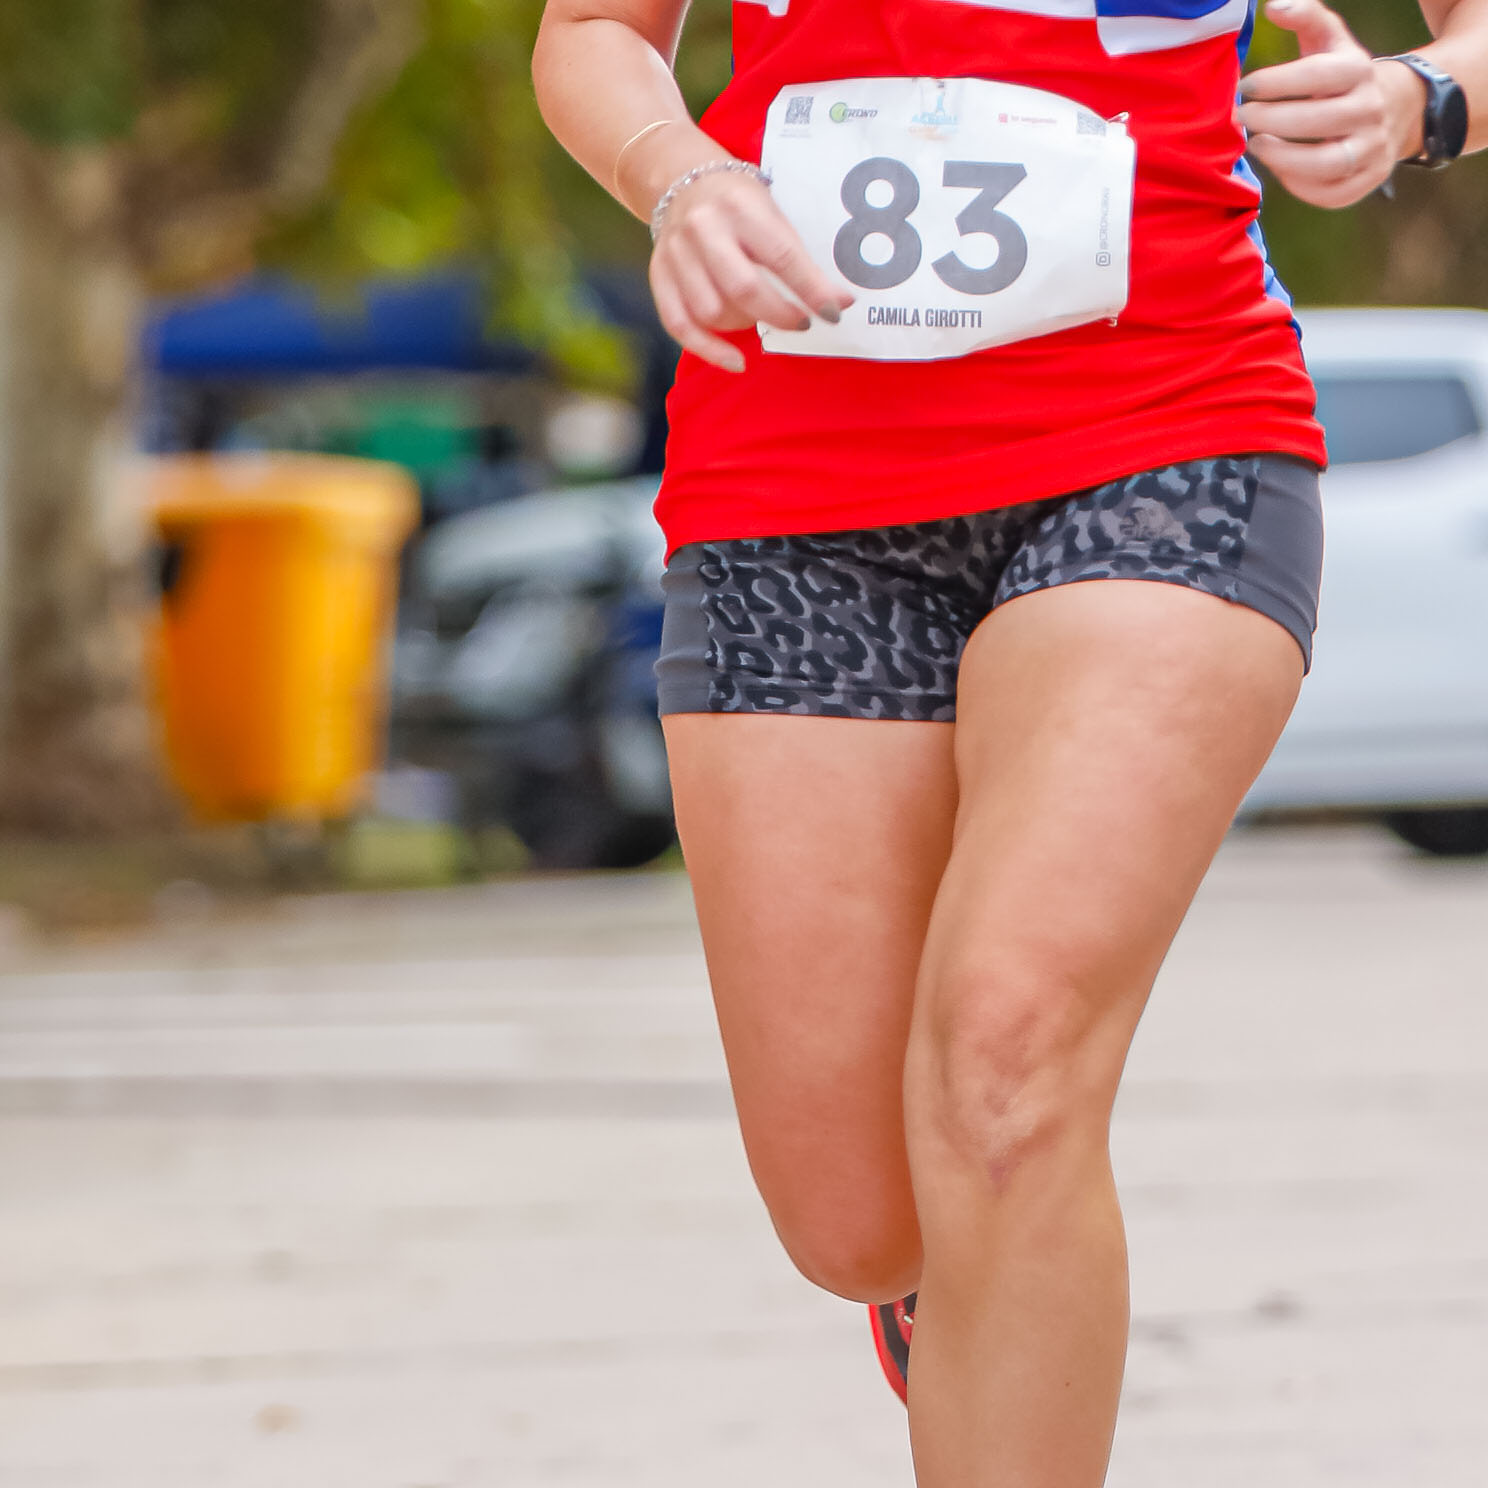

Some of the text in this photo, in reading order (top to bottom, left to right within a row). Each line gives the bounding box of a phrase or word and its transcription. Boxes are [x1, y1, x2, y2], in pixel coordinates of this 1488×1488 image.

[833, 157, 1028, 295] 83
[867, 306, 982, 330] CAMILA GIROTTI
